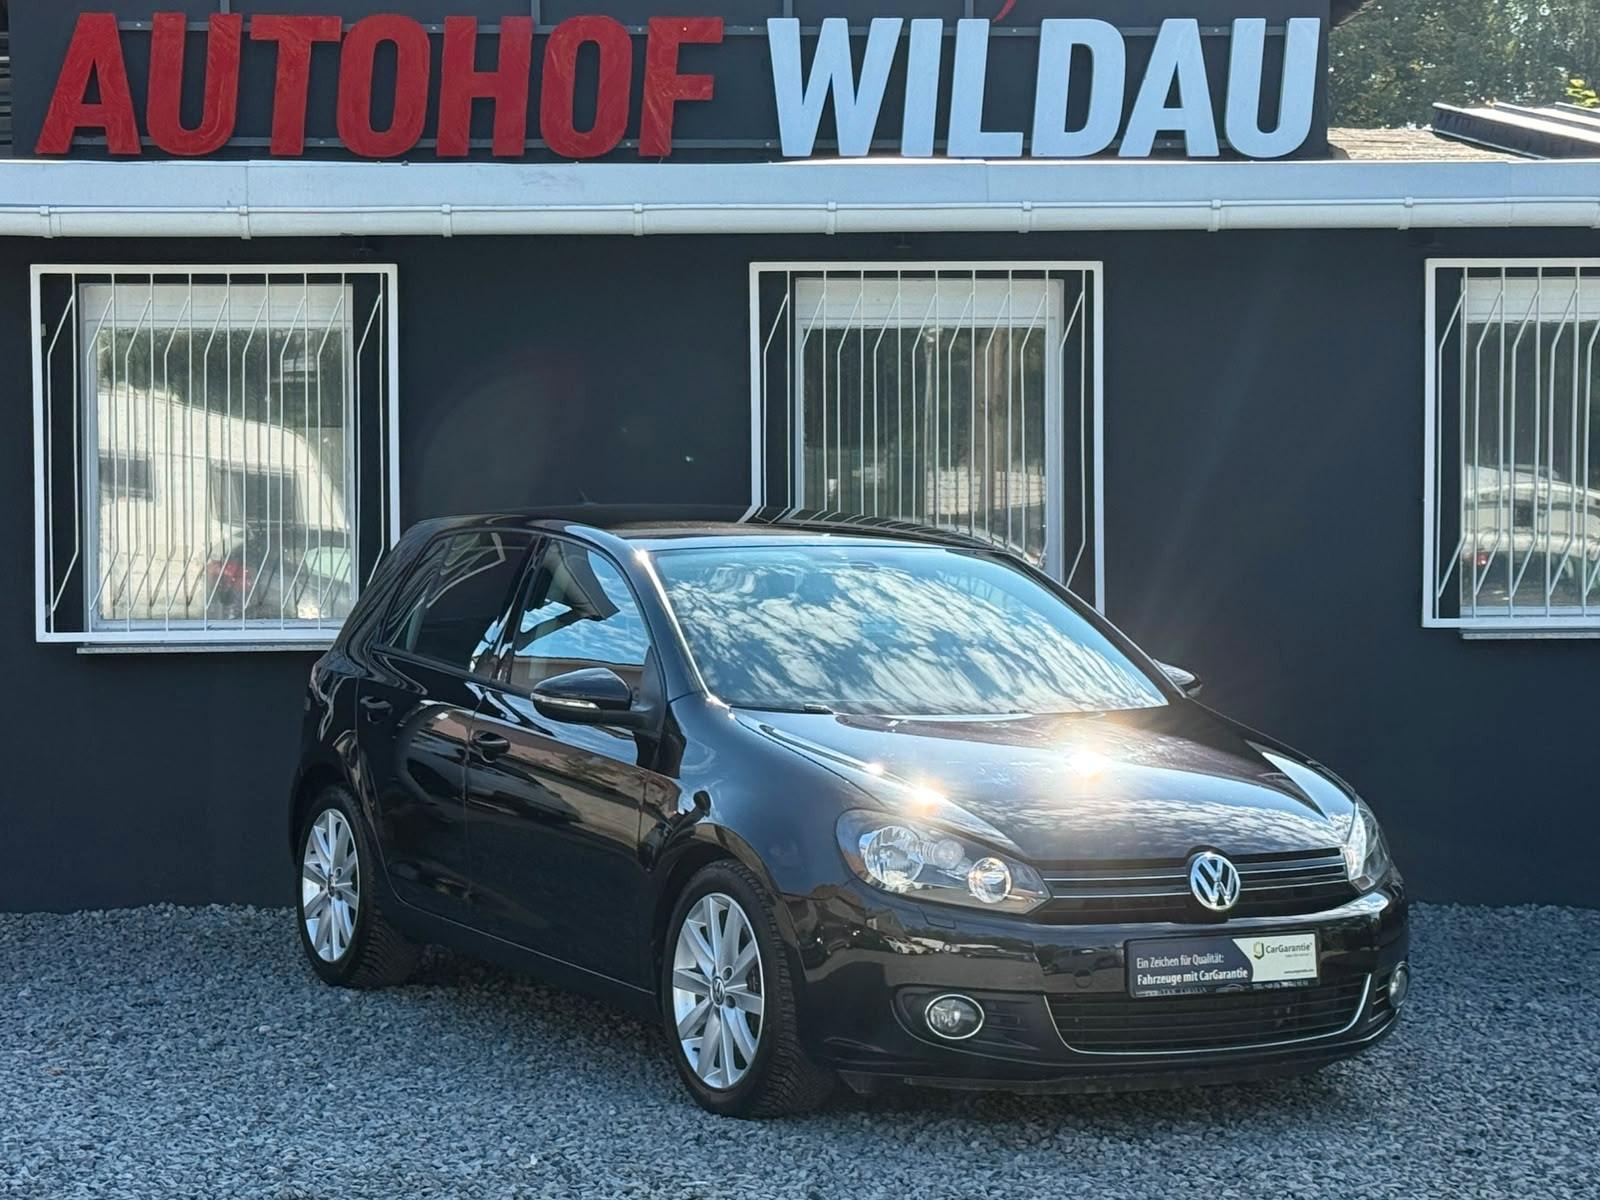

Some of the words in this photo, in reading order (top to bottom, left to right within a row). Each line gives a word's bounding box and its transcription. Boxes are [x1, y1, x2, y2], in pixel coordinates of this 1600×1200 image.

[36, 13, 724, 157] AUTOHOF
[767, 17, 1320, 157] WILDAU
[1136, 957, 1149, 969] Ein
[1150, 956, 1180, 968] Zeichen
[1180, 954, 1192, 966] für
[1192, 953, 1225, 966] Qualität:
[1137, 973, 1181, 986] Fahrzeuge
[1183, 971, 1199, 982] mit
[1199, 967, 1249, 981] CarGarantie
